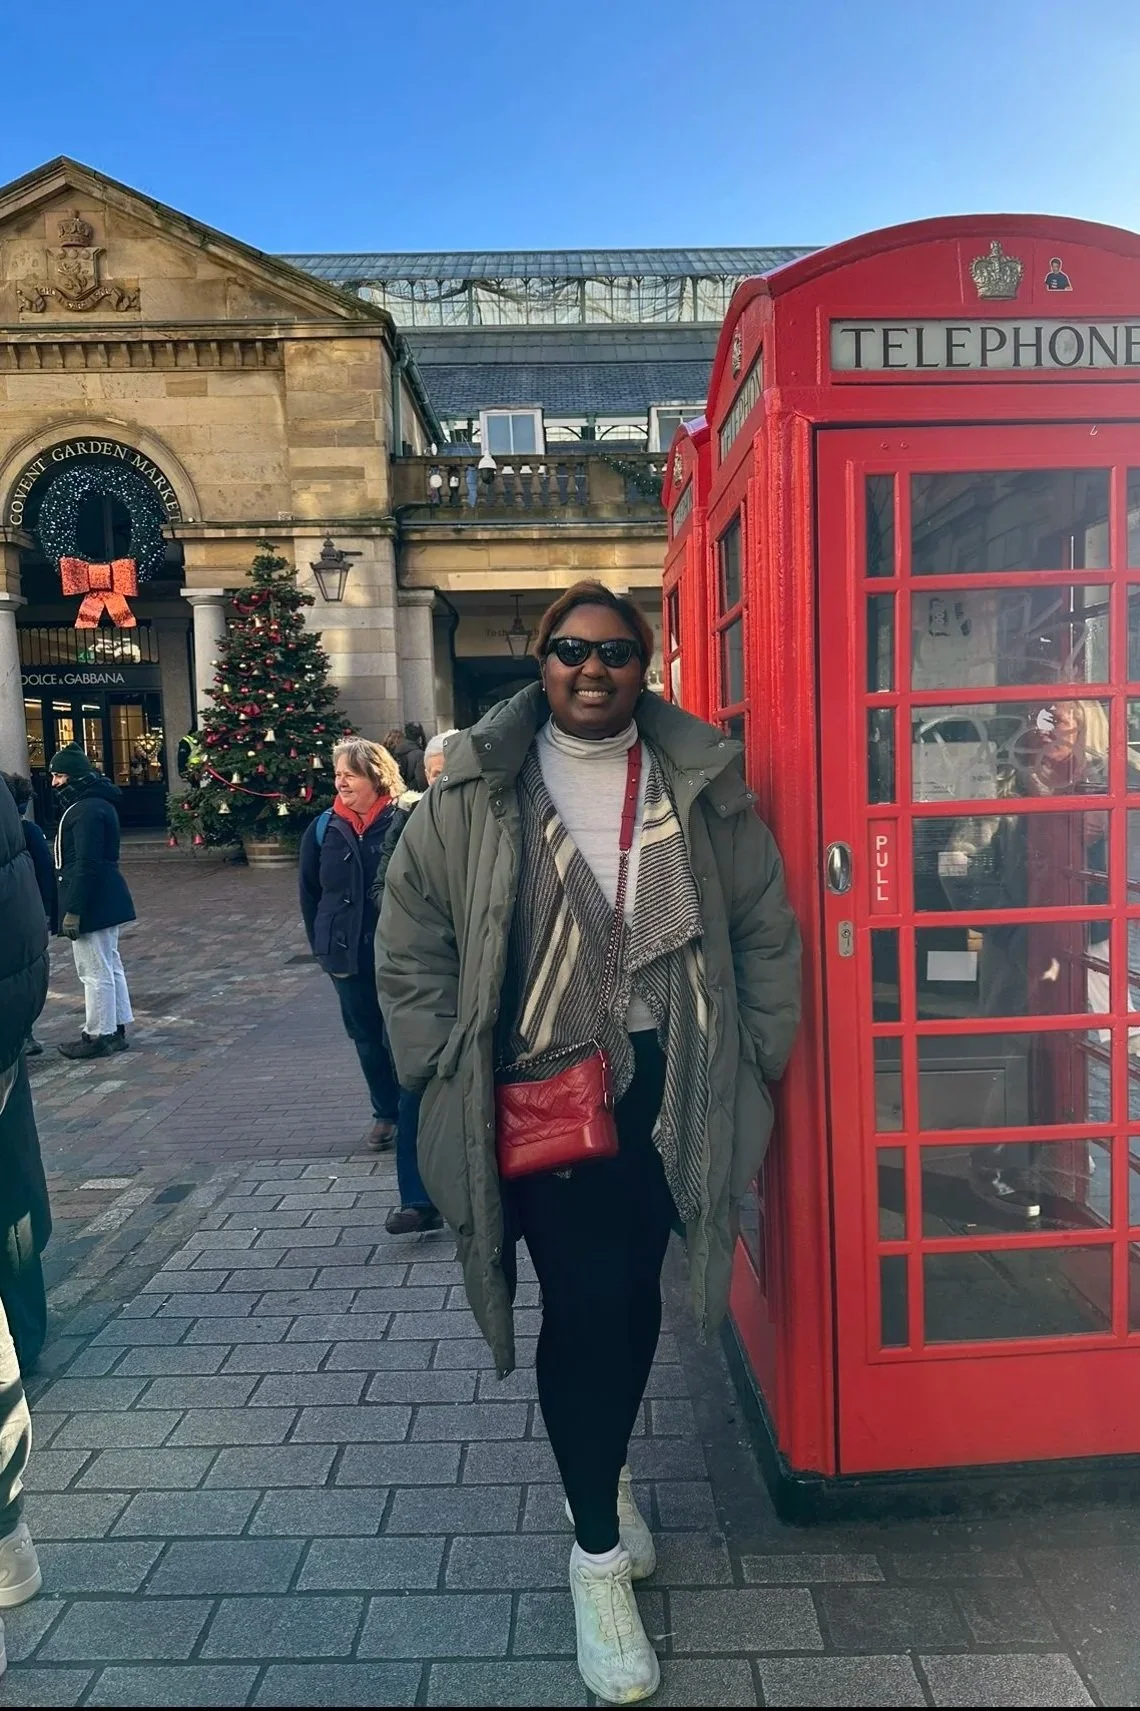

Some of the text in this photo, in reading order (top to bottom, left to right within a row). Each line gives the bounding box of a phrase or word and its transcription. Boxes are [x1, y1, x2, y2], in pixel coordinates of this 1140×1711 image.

[840, 325, 1140, 369] TELEPHONE
[721, 366, 763, 458] TELEPHON
[10, 440, 182, 525] COVENT GARDEN MARKET
[64, 672, 125, 685] GABBANA
[876, 835, 889, 901] PULL
